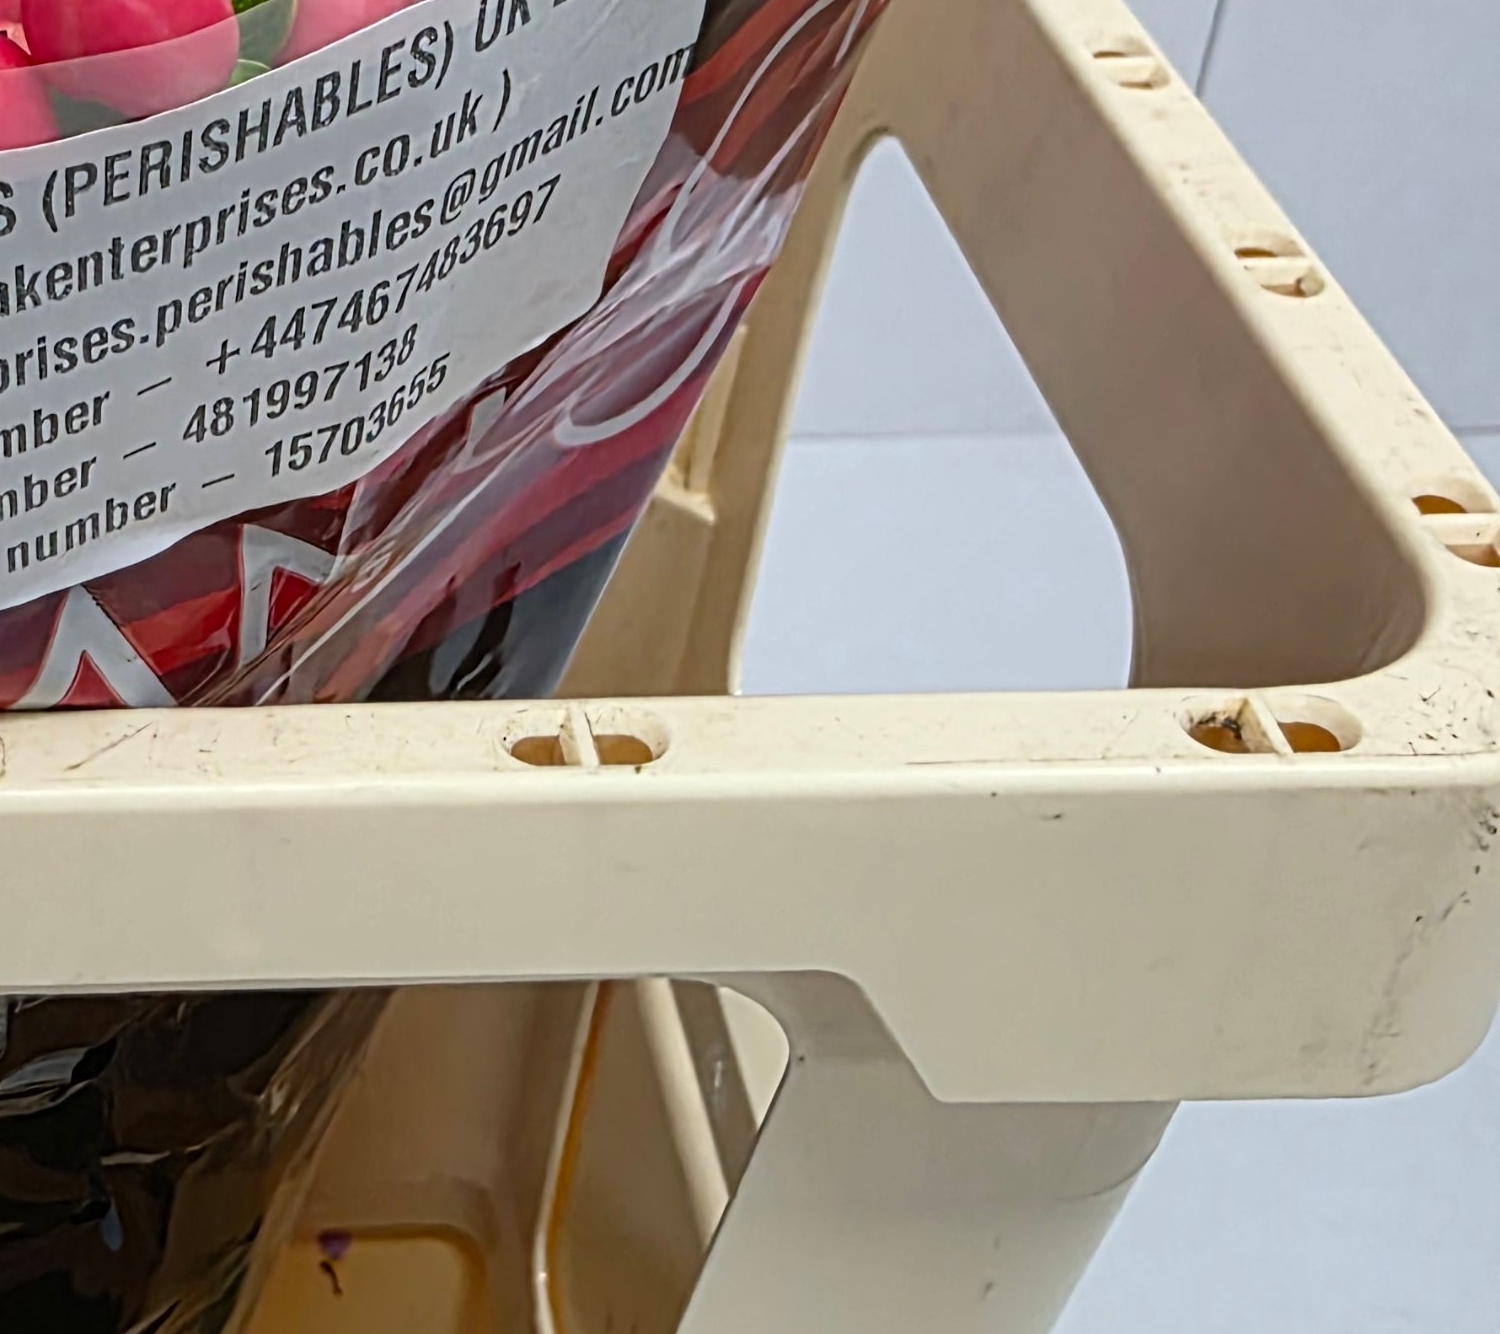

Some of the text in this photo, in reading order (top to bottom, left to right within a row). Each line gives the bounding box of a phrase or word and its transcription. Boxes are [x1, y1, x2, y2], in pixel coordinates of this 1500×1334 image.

[43, 20, 453, 232] (PERISHABLES)
[206, 174, 561, 374] +447467483697
[7, 482, 176, 573] number
[265, 352, 450, 476] 15703655
[183, 323, 418, 443] 481997138
